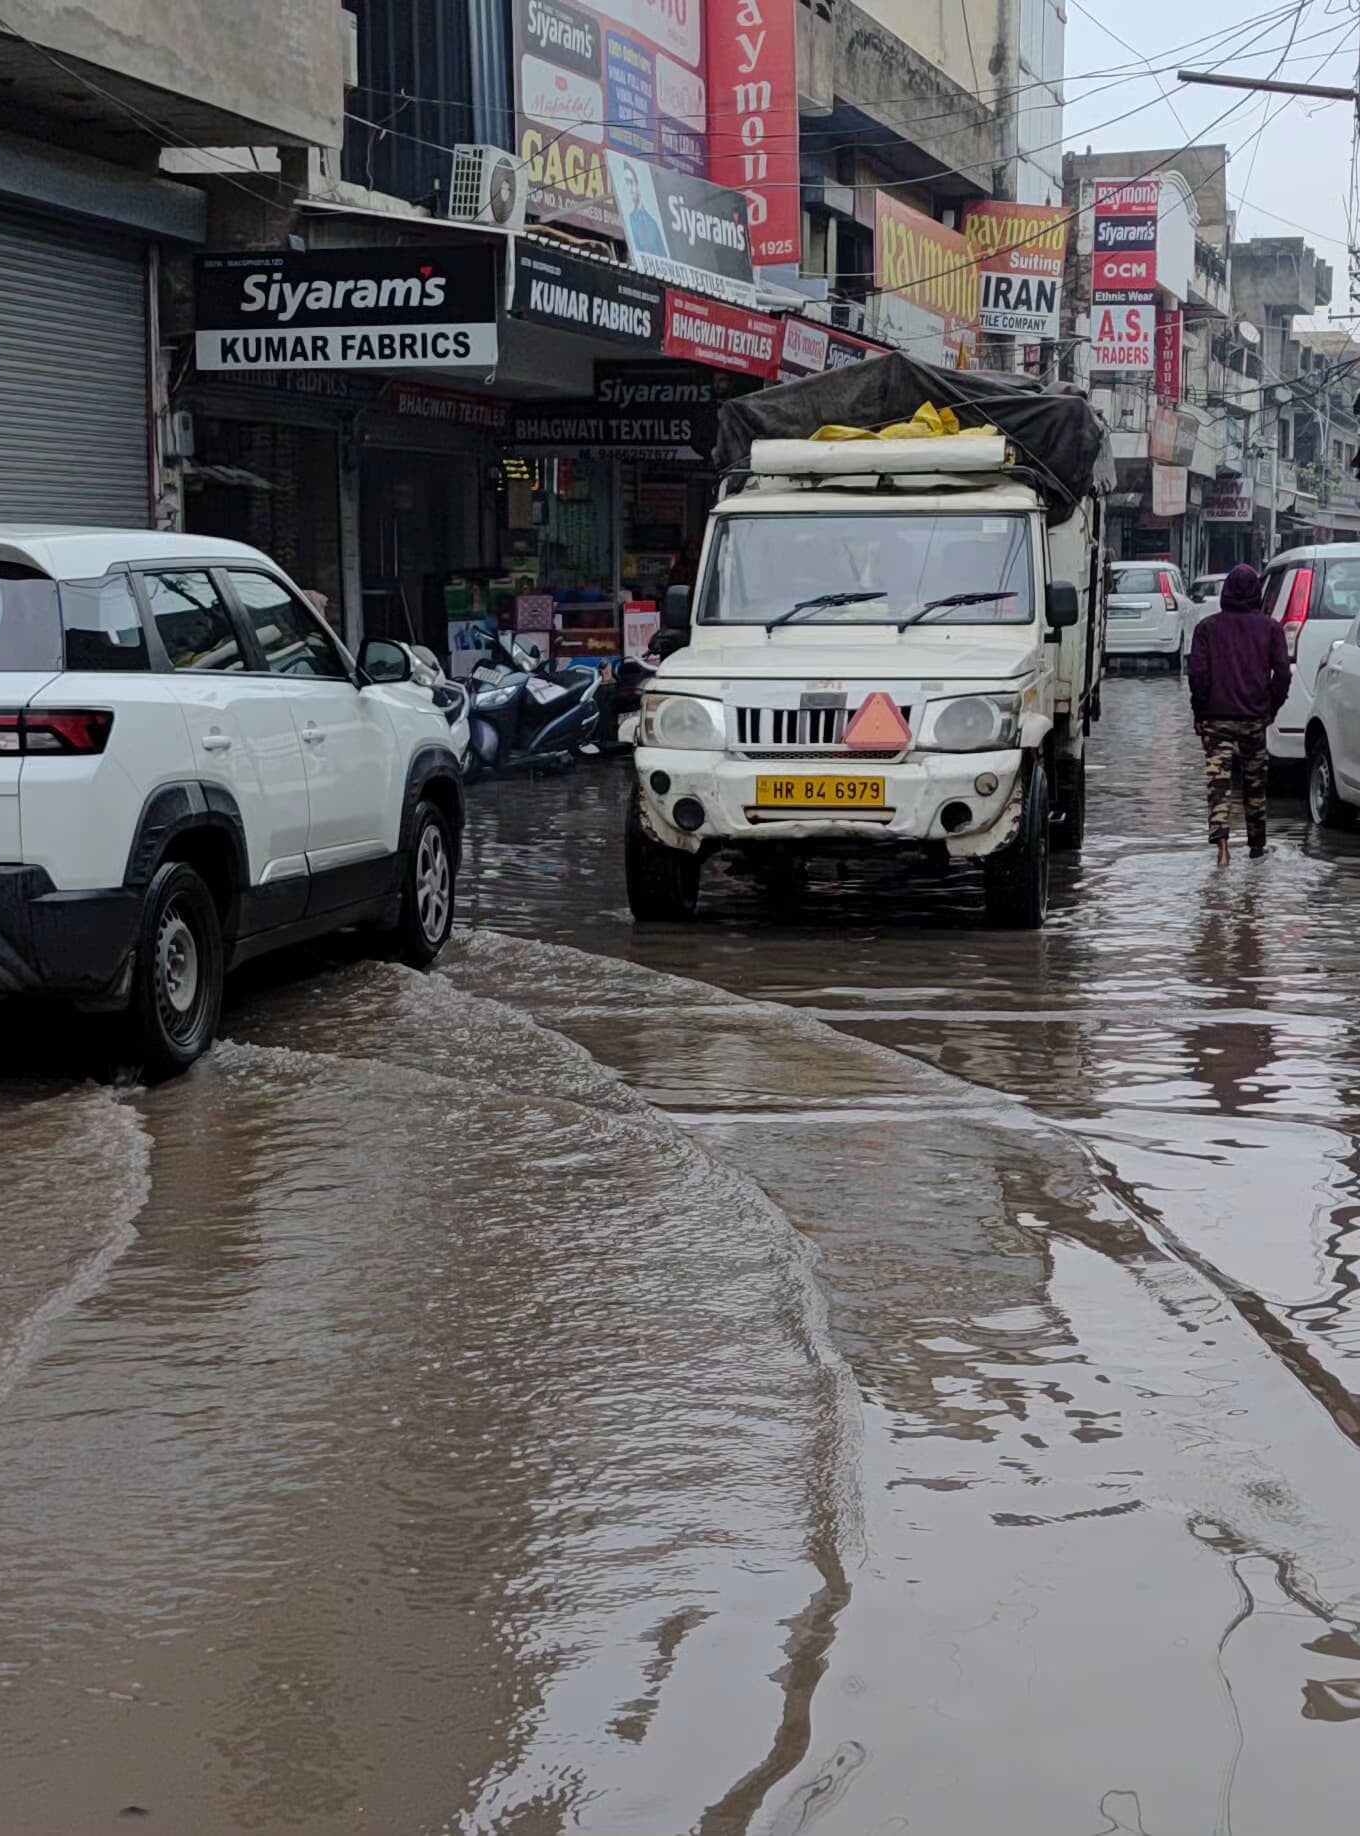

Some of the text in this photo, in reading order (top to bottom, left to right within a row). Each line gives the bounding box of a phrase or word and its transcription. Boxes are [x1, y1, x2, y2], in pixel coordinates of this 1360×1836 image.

[759, 240, 793, 257] 1925
[1010, 252, 1061, 275] Suiting
[1103, 262, 1147, 278] OCM
[982, 275, 1058, 313] IRAN
[1095, 290, 1154, 302] Ethnic Wear
[530, 279, 589, 324] KUMAR
[592, 296, 652, 338] FABRICS
[1002, 314, 1047, 331] COMPANY
[1098, 308, 1149, 343] A.S.
[220, 331, 471, 363] KUMAR FABRICS
[672, 312, 726, 350] BHAGWATI
[727, 328, 773, 361] TEXTILES
[1096, 346, 1149, 365] TRADERS
[398, 392, 507, 428] BHAGWATI TEXTILES
[515, 418, 692, 441] BHAGWATI TEXTILES
[773, 782, 796, 800] HR
[804, 782, 826, 800] 84
[834, 781, 881, 800] 6979
